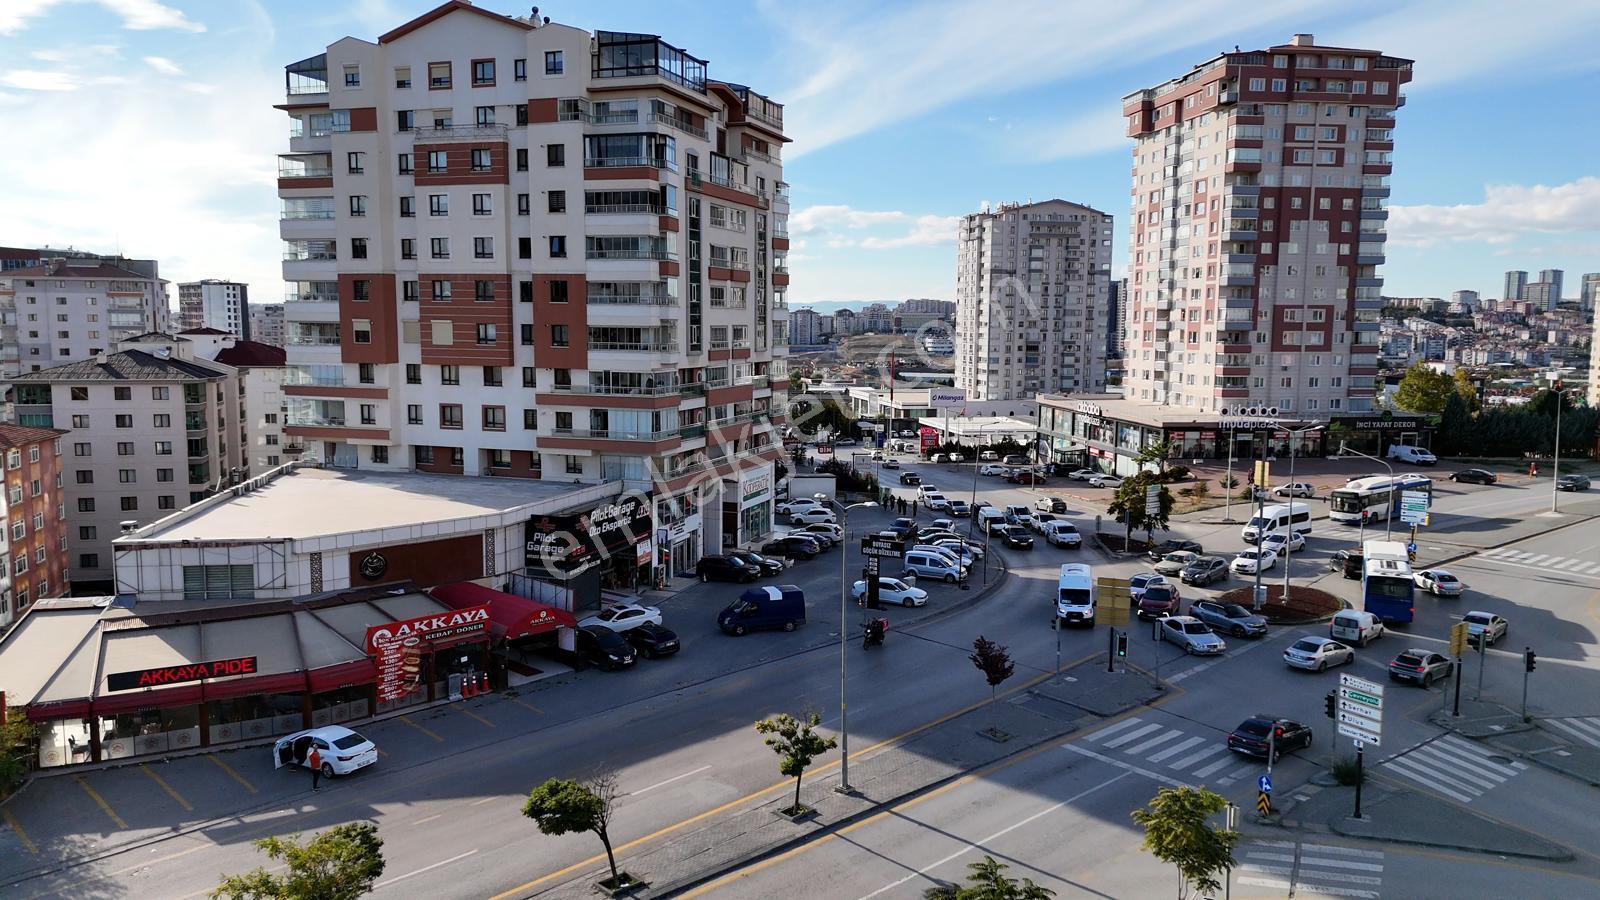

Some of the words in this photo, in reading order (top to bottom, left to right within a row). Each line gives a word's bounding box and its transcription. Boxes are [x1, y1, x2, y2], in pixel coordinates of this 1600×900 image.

[937, 395, 964, 403] Milangaz
[1220, 404, 1279, 417] akbaba
[602, 516, 632, 533] Ekspertiz
[533, 532, 557, 543] Pilot
[396, 609, 489, 637] AKKAYA
[531, 616, 555, 624] AKKAYA
[425, 630, 453, 640] KEBAP
[139, 665, 209, 685] AKKAYA
[213, 659, 254, 675] PIDE
[1348, 704, 1372, 715] Serhat
[1348, 716, 1364, 726] Ulus
